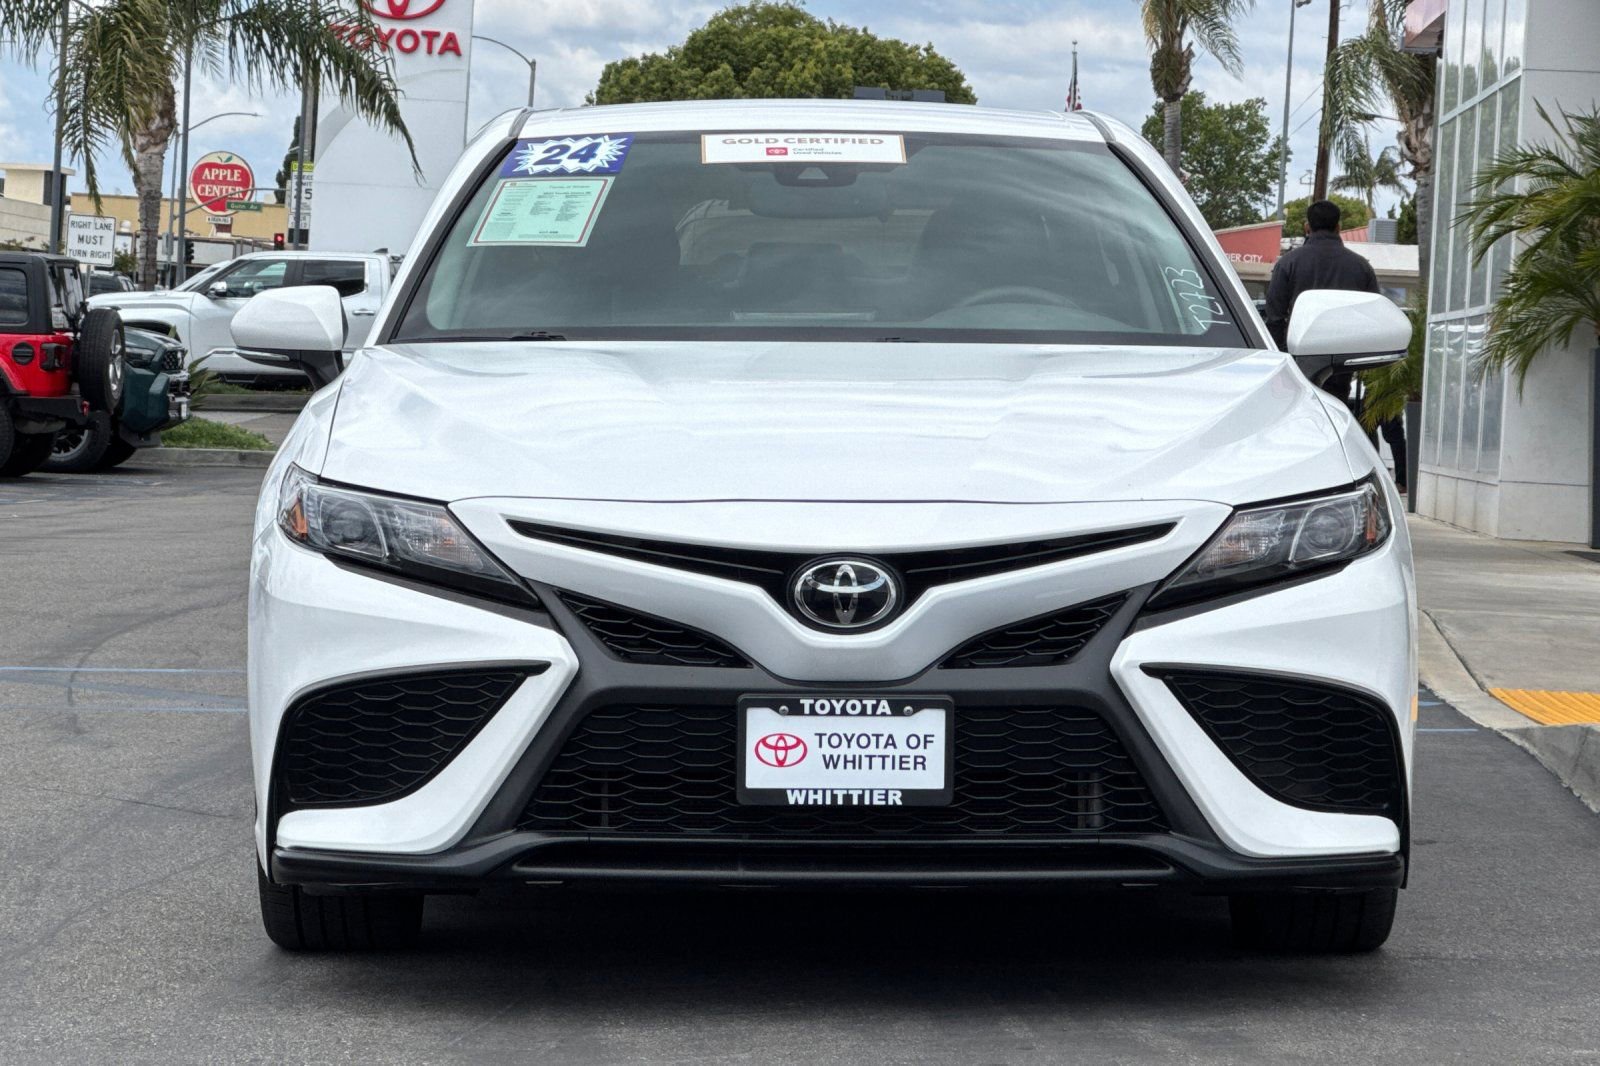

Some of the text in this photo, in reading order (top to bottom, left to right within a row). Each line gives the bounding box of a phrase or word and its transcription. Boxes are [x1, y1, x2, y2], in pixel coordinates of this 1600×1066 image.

[722, 137, 884, 145] GOLD CERTIFIED
[532, 141, 603, 167] 24
[202, 168, 242, 182] APPLE
[197, 184, 244, 199] CENTER
[70, 220, 112, 231] RIGHT LANE
[77, 234, 104, 246] MUST
[69, 249, 112, 260] TURN RIGHT
[1242, 254, 1263, 263] CITY
[800, 699, 892, 716] TOYOTA
[814, 732, 935, 750] TOYOTA OF
[822, 754, 927, 771] WHITTIER
[786, 789, 903, 805] WHITTIER
